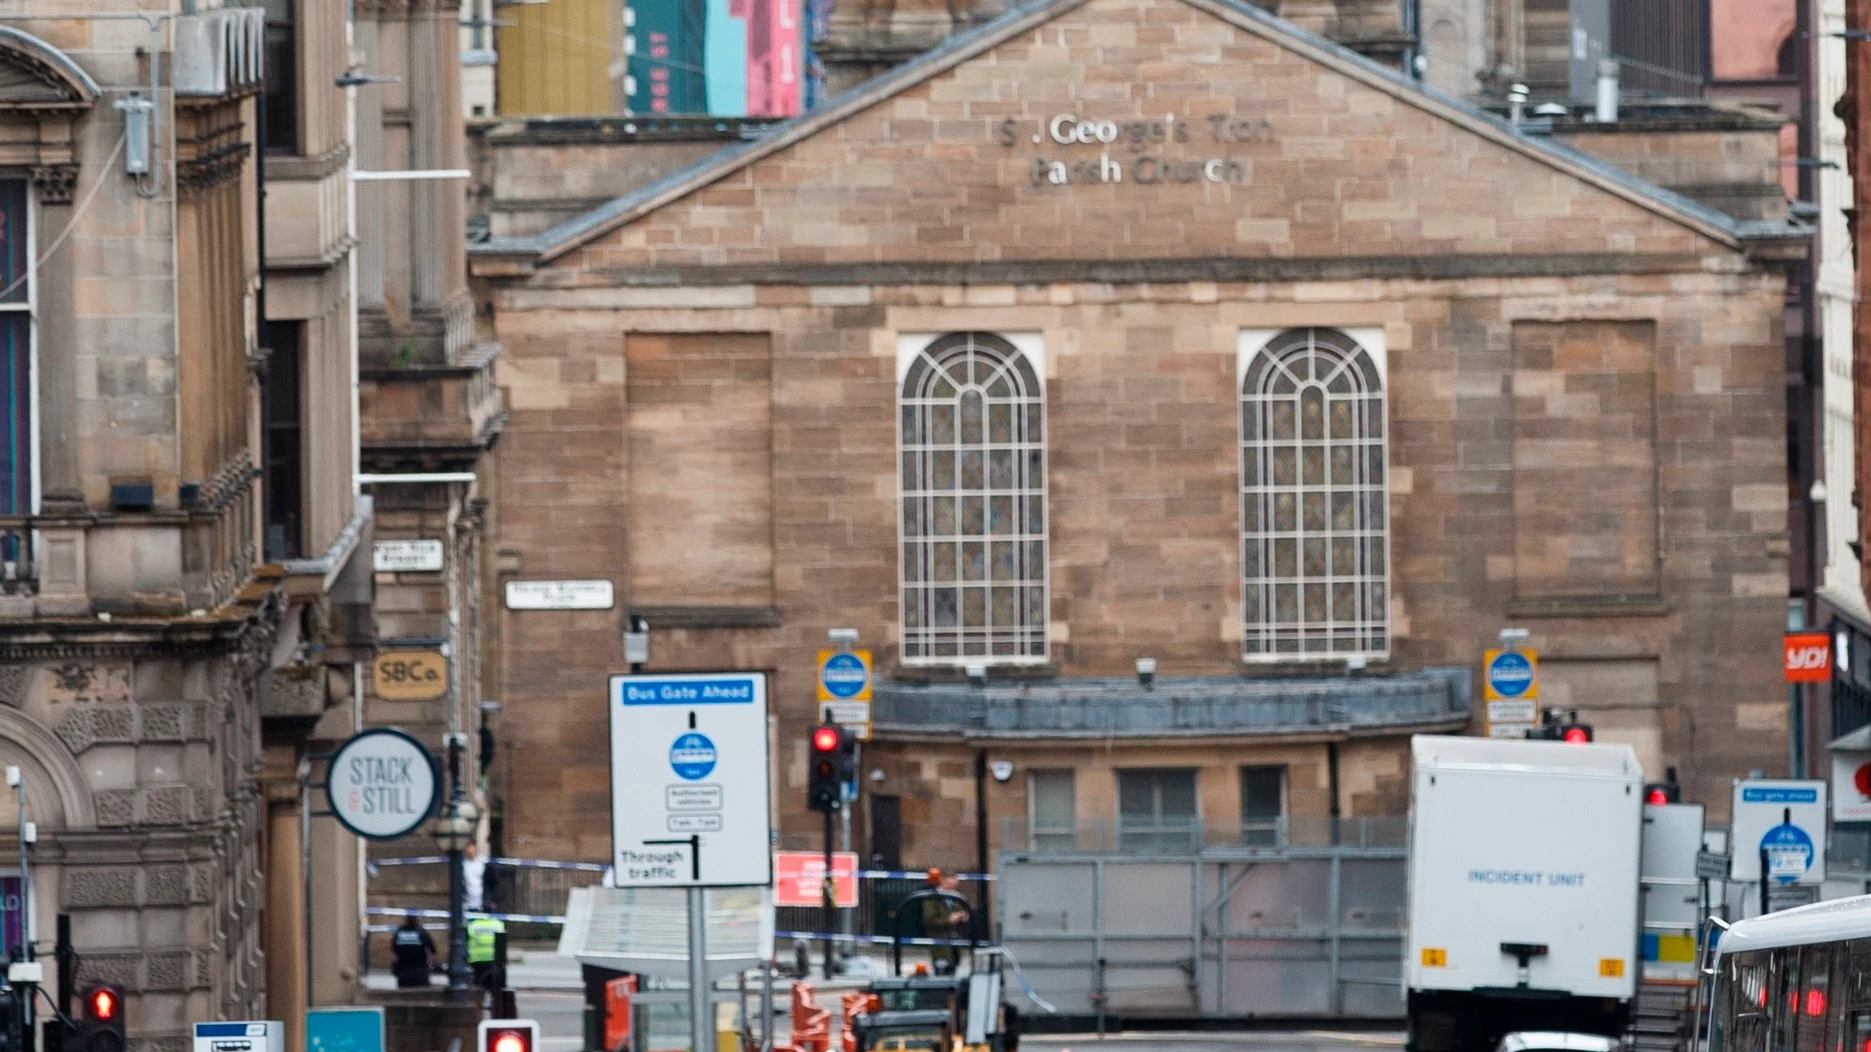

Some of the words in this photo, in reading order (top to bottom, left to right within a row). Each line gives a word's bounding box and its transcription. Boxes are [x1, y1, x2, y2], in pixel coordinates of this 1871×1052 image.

[1050, 112, 1190, 153] George's
[1787, 646, 1829, 669] YO!
[627, 686, 656, 701] Bus
[661, 685, 698, 701] Gate
[702, 684, 750, 699] Ahead
[349, 756, 414, 785] STACK
[362, 787, 416, 815] STILL
[621, 851, 684, 866] Through
[628, 864, 677, 880] traffic
[1467, 869, 1542, 886] INCIDENT
[1548, 871, 1586, 887] UNIT
